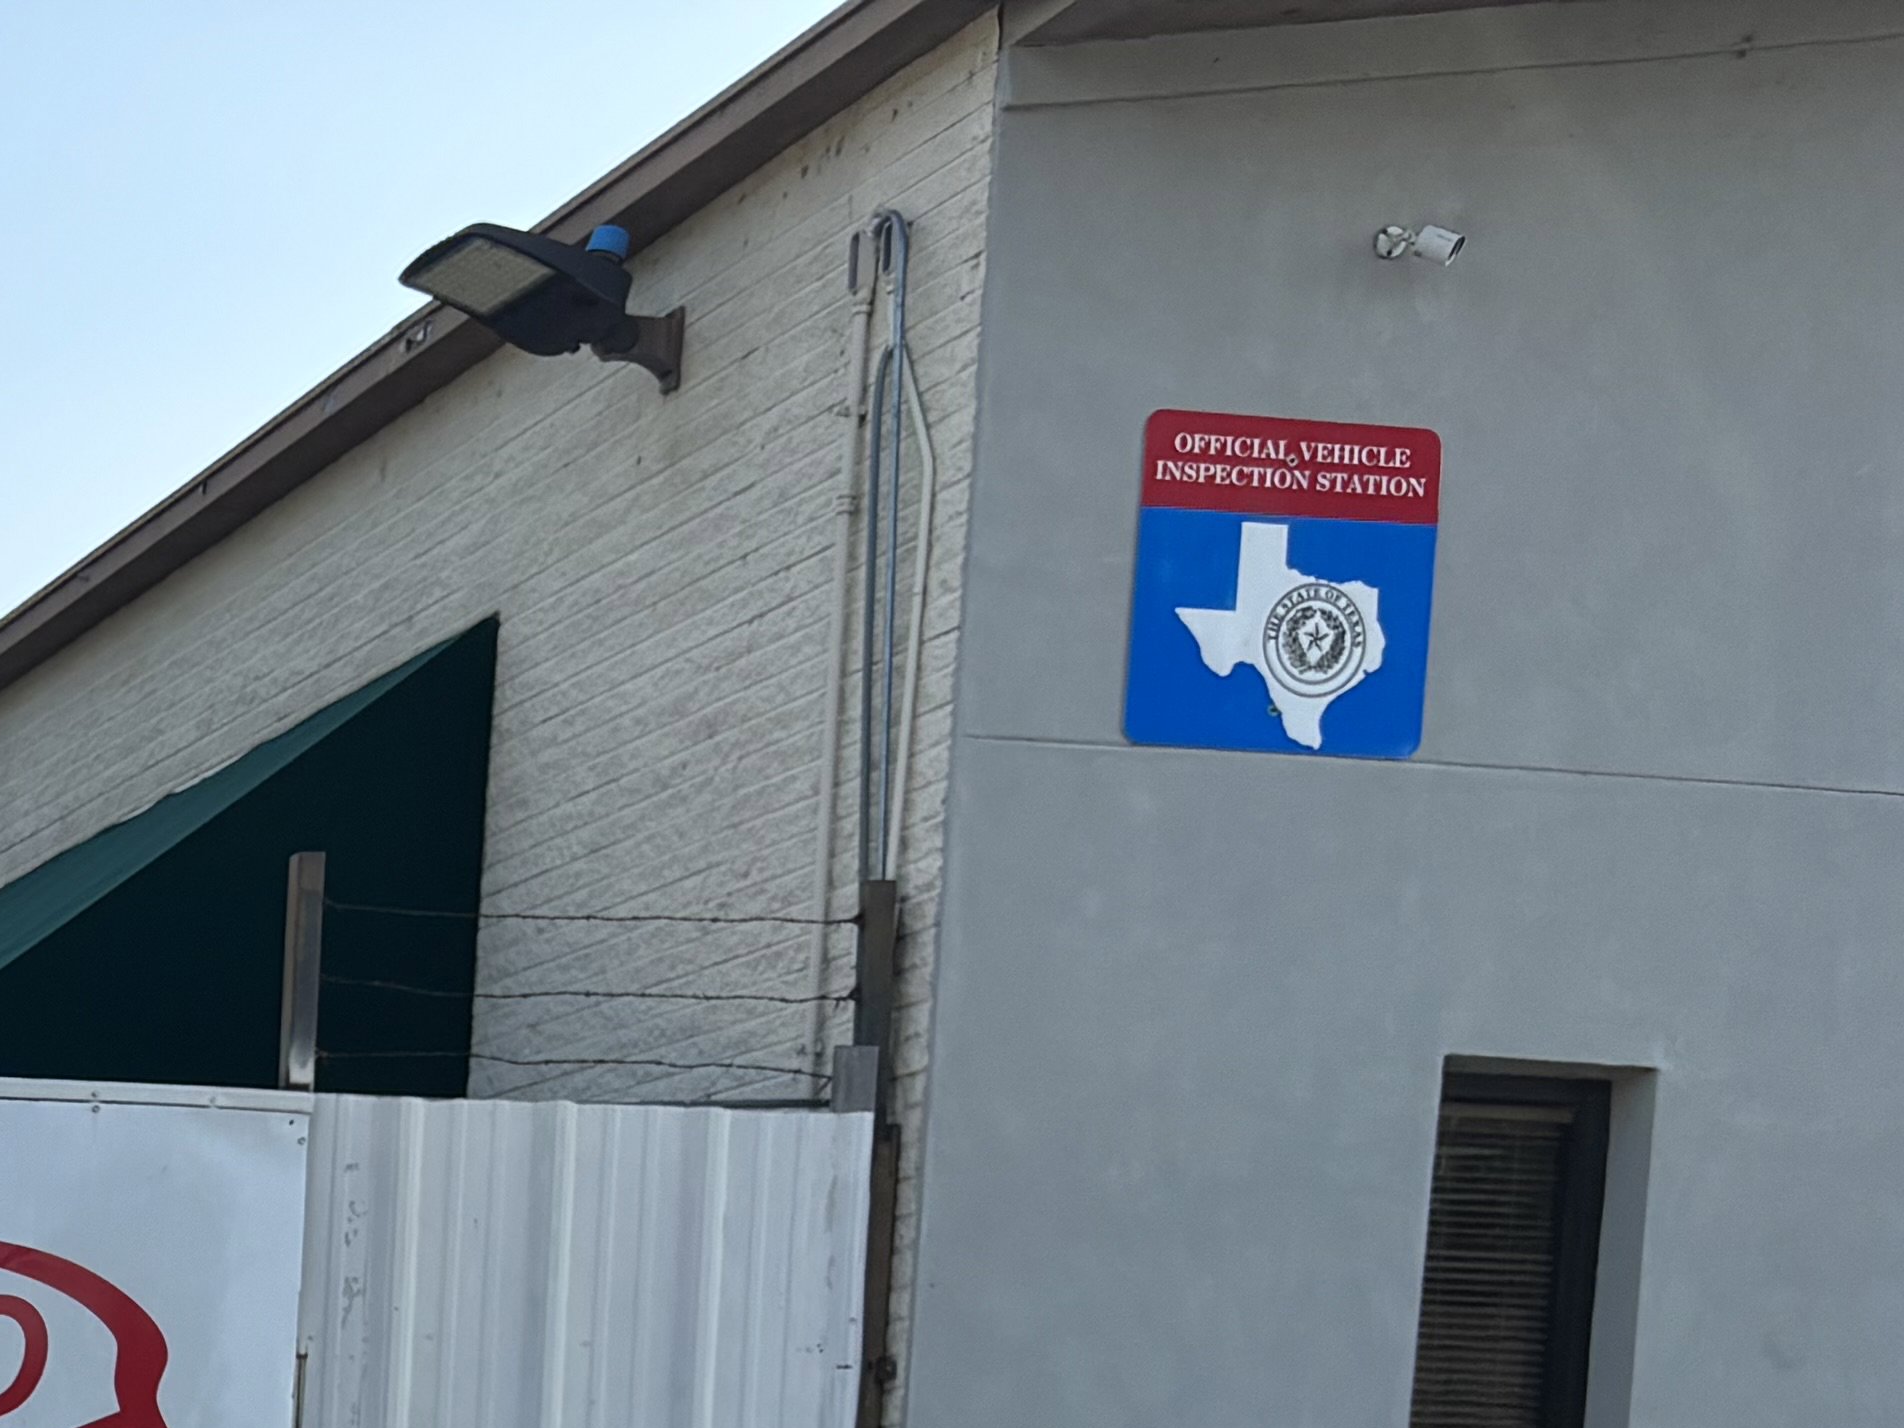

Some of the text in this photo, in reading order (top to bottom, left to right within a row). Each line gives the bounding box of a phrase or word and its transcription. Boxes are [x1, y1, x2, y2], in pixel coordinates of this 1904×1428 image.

[1174, 431, 1411, 468] OFFICIAL VEHICLE
[1154, 459, 1427, 498] INSPECTION STATION
